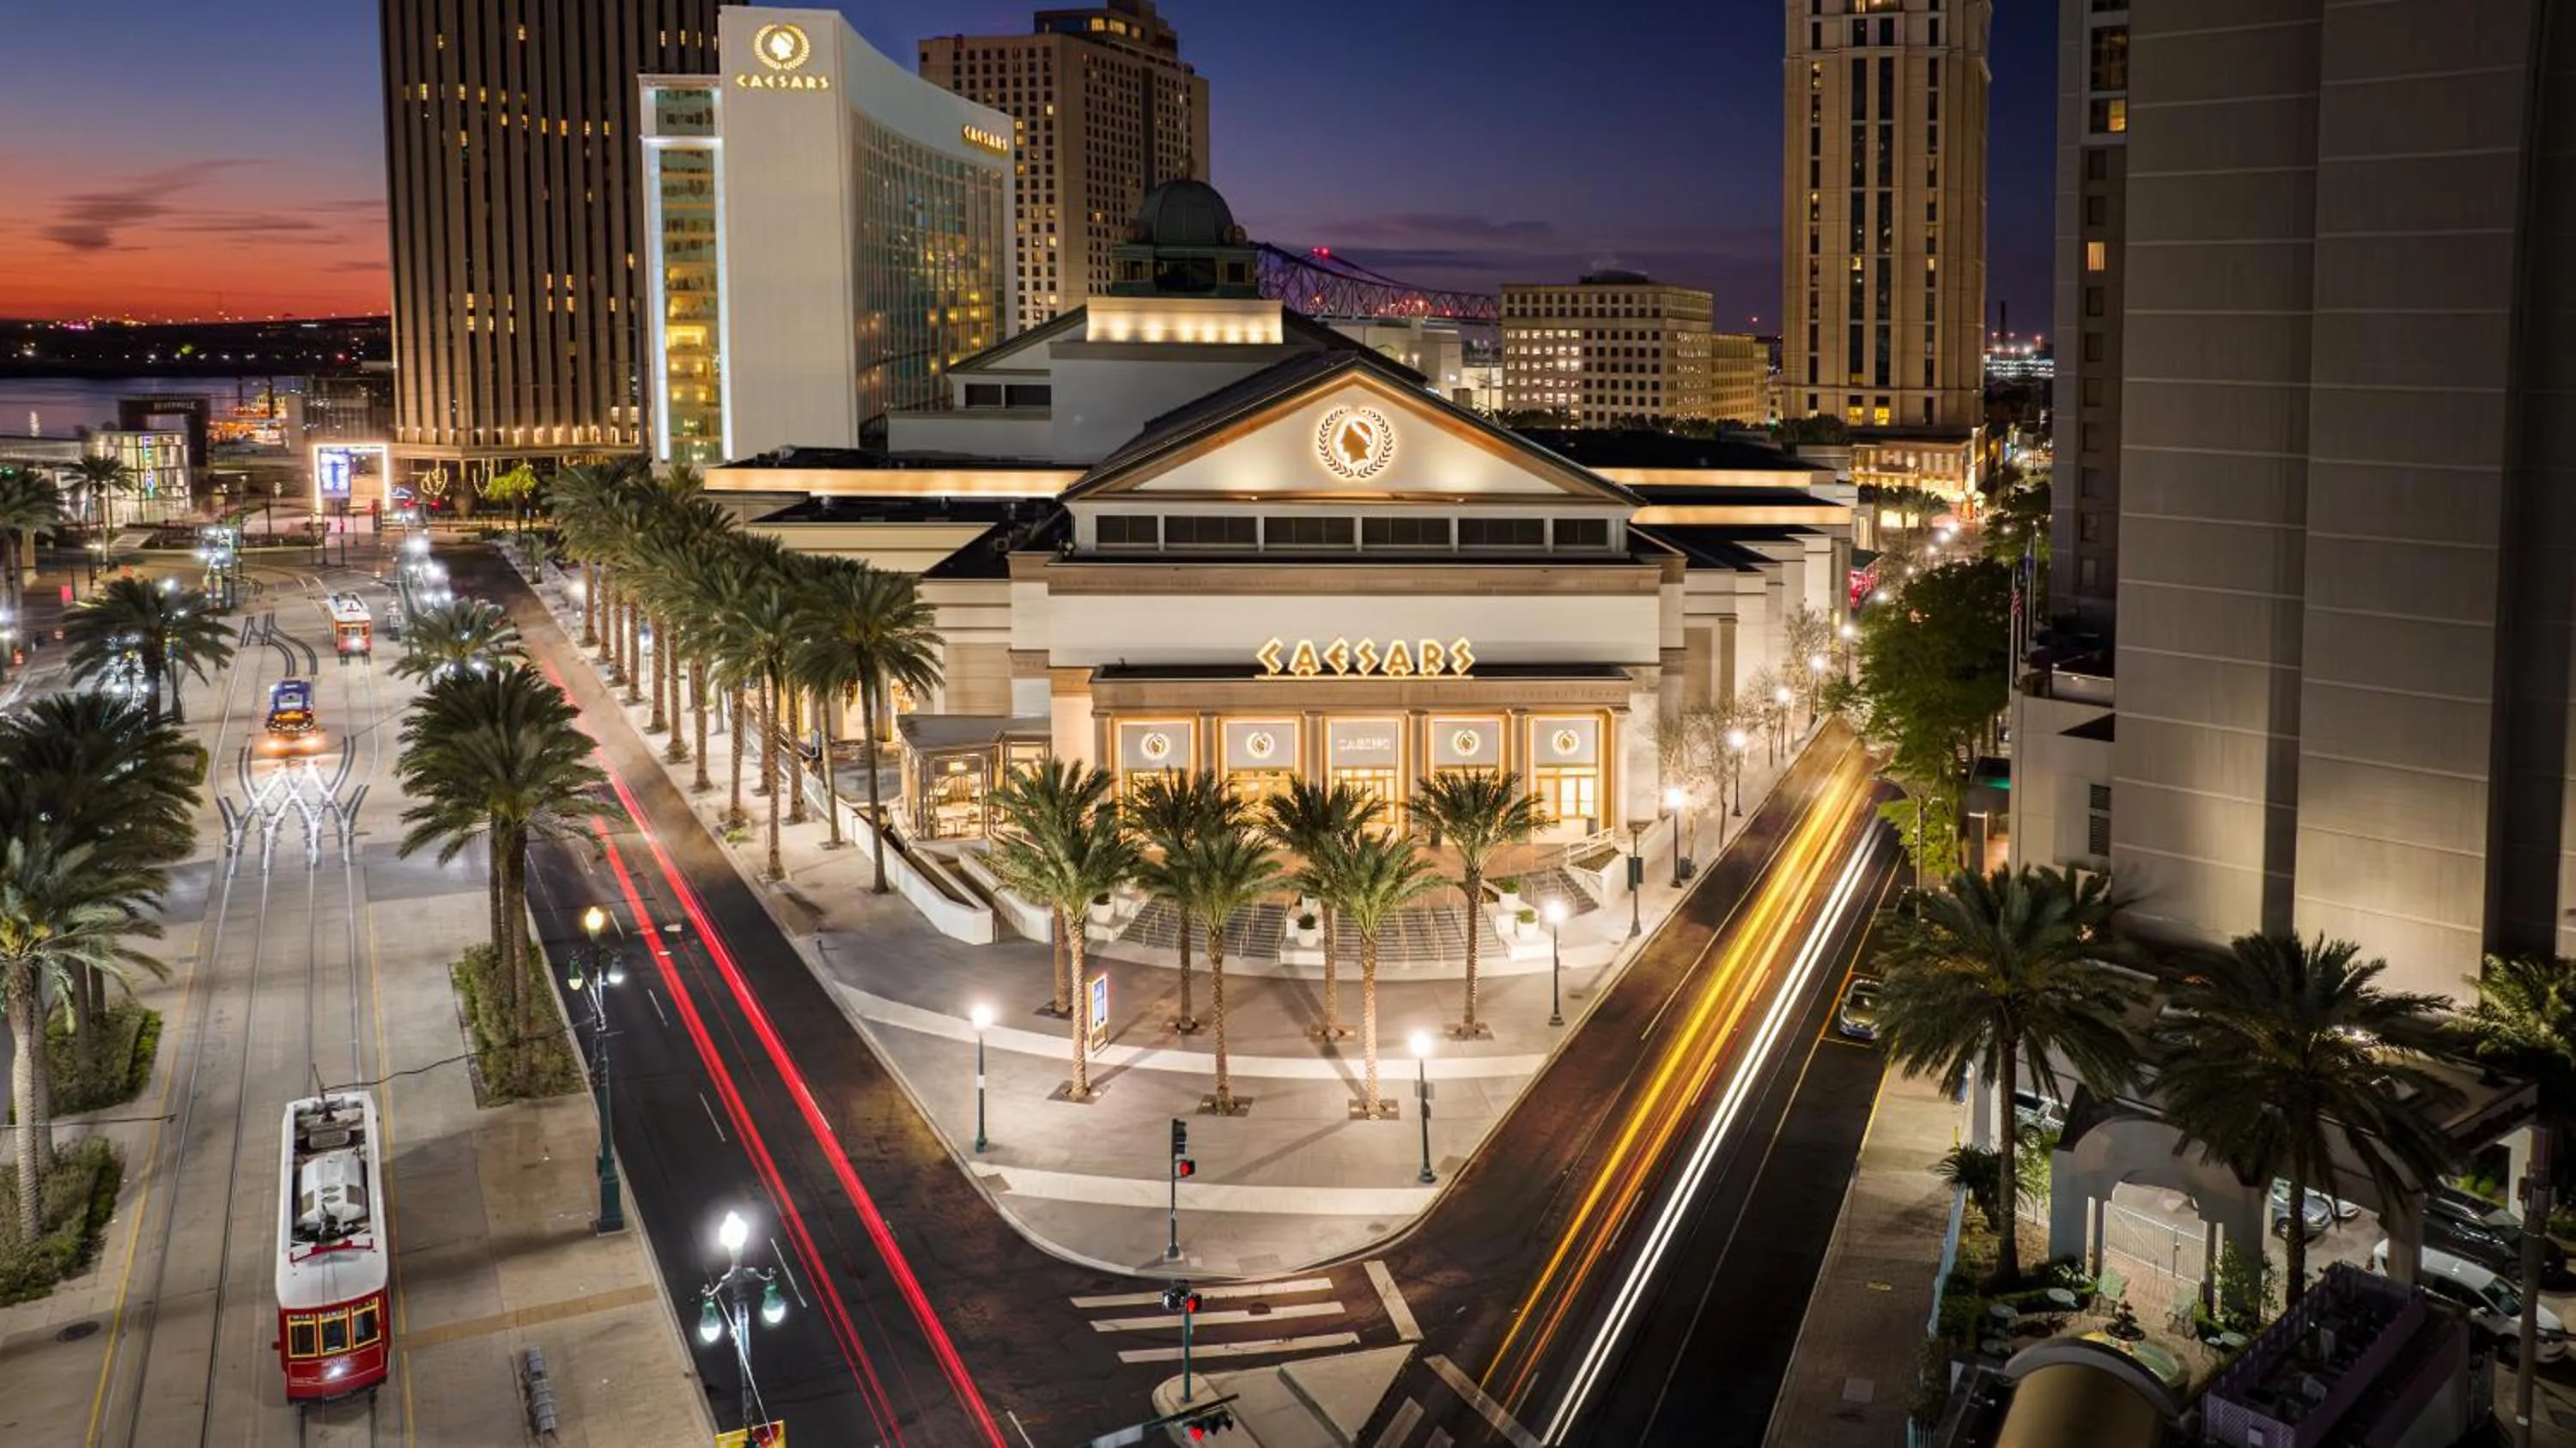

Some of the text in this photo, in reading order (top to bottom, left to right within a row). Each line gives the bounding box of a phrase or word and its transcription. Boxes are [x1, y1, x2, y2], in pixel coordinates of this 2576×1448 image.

[735, 73, 830, 89] CAESARS
[962, 125, 1009, 153] CAESARS
[1255, 637, 1476, 676] CAESARS
